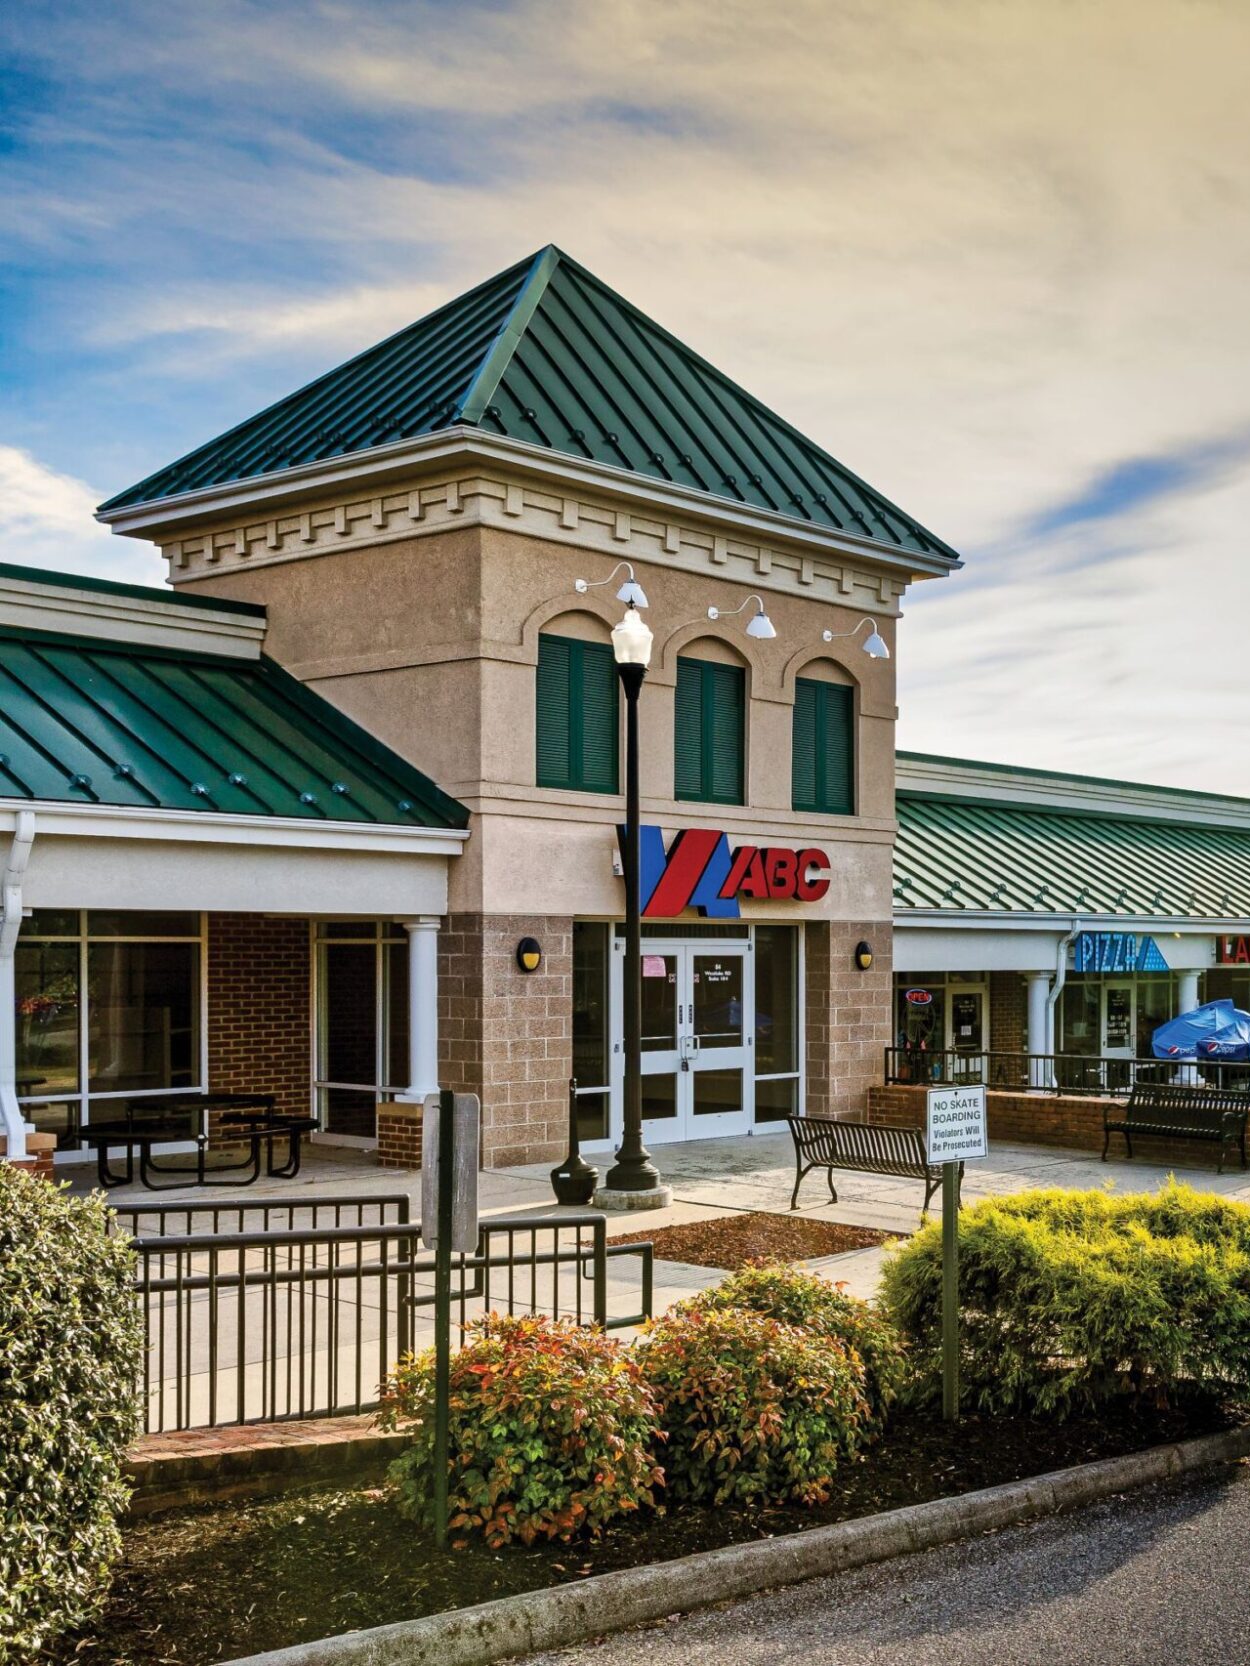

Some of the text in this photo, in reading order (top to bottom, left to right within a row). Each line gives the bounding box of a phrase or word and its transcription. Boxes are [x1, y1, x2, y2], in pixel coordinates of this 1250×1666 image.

[718, 846, 831, 902] ABC
[1082, 933, 1137, 972] PIZZA
[908, 991, 929, 1002] OPEN
[933, 1098, 979, 1111] NO SKATE
[932, 1110, 981, 1124] BOARDING
[934, 1126, 980, 1139] Violators Will
[932, 1138, 982, 1152] Be Prosecuted
